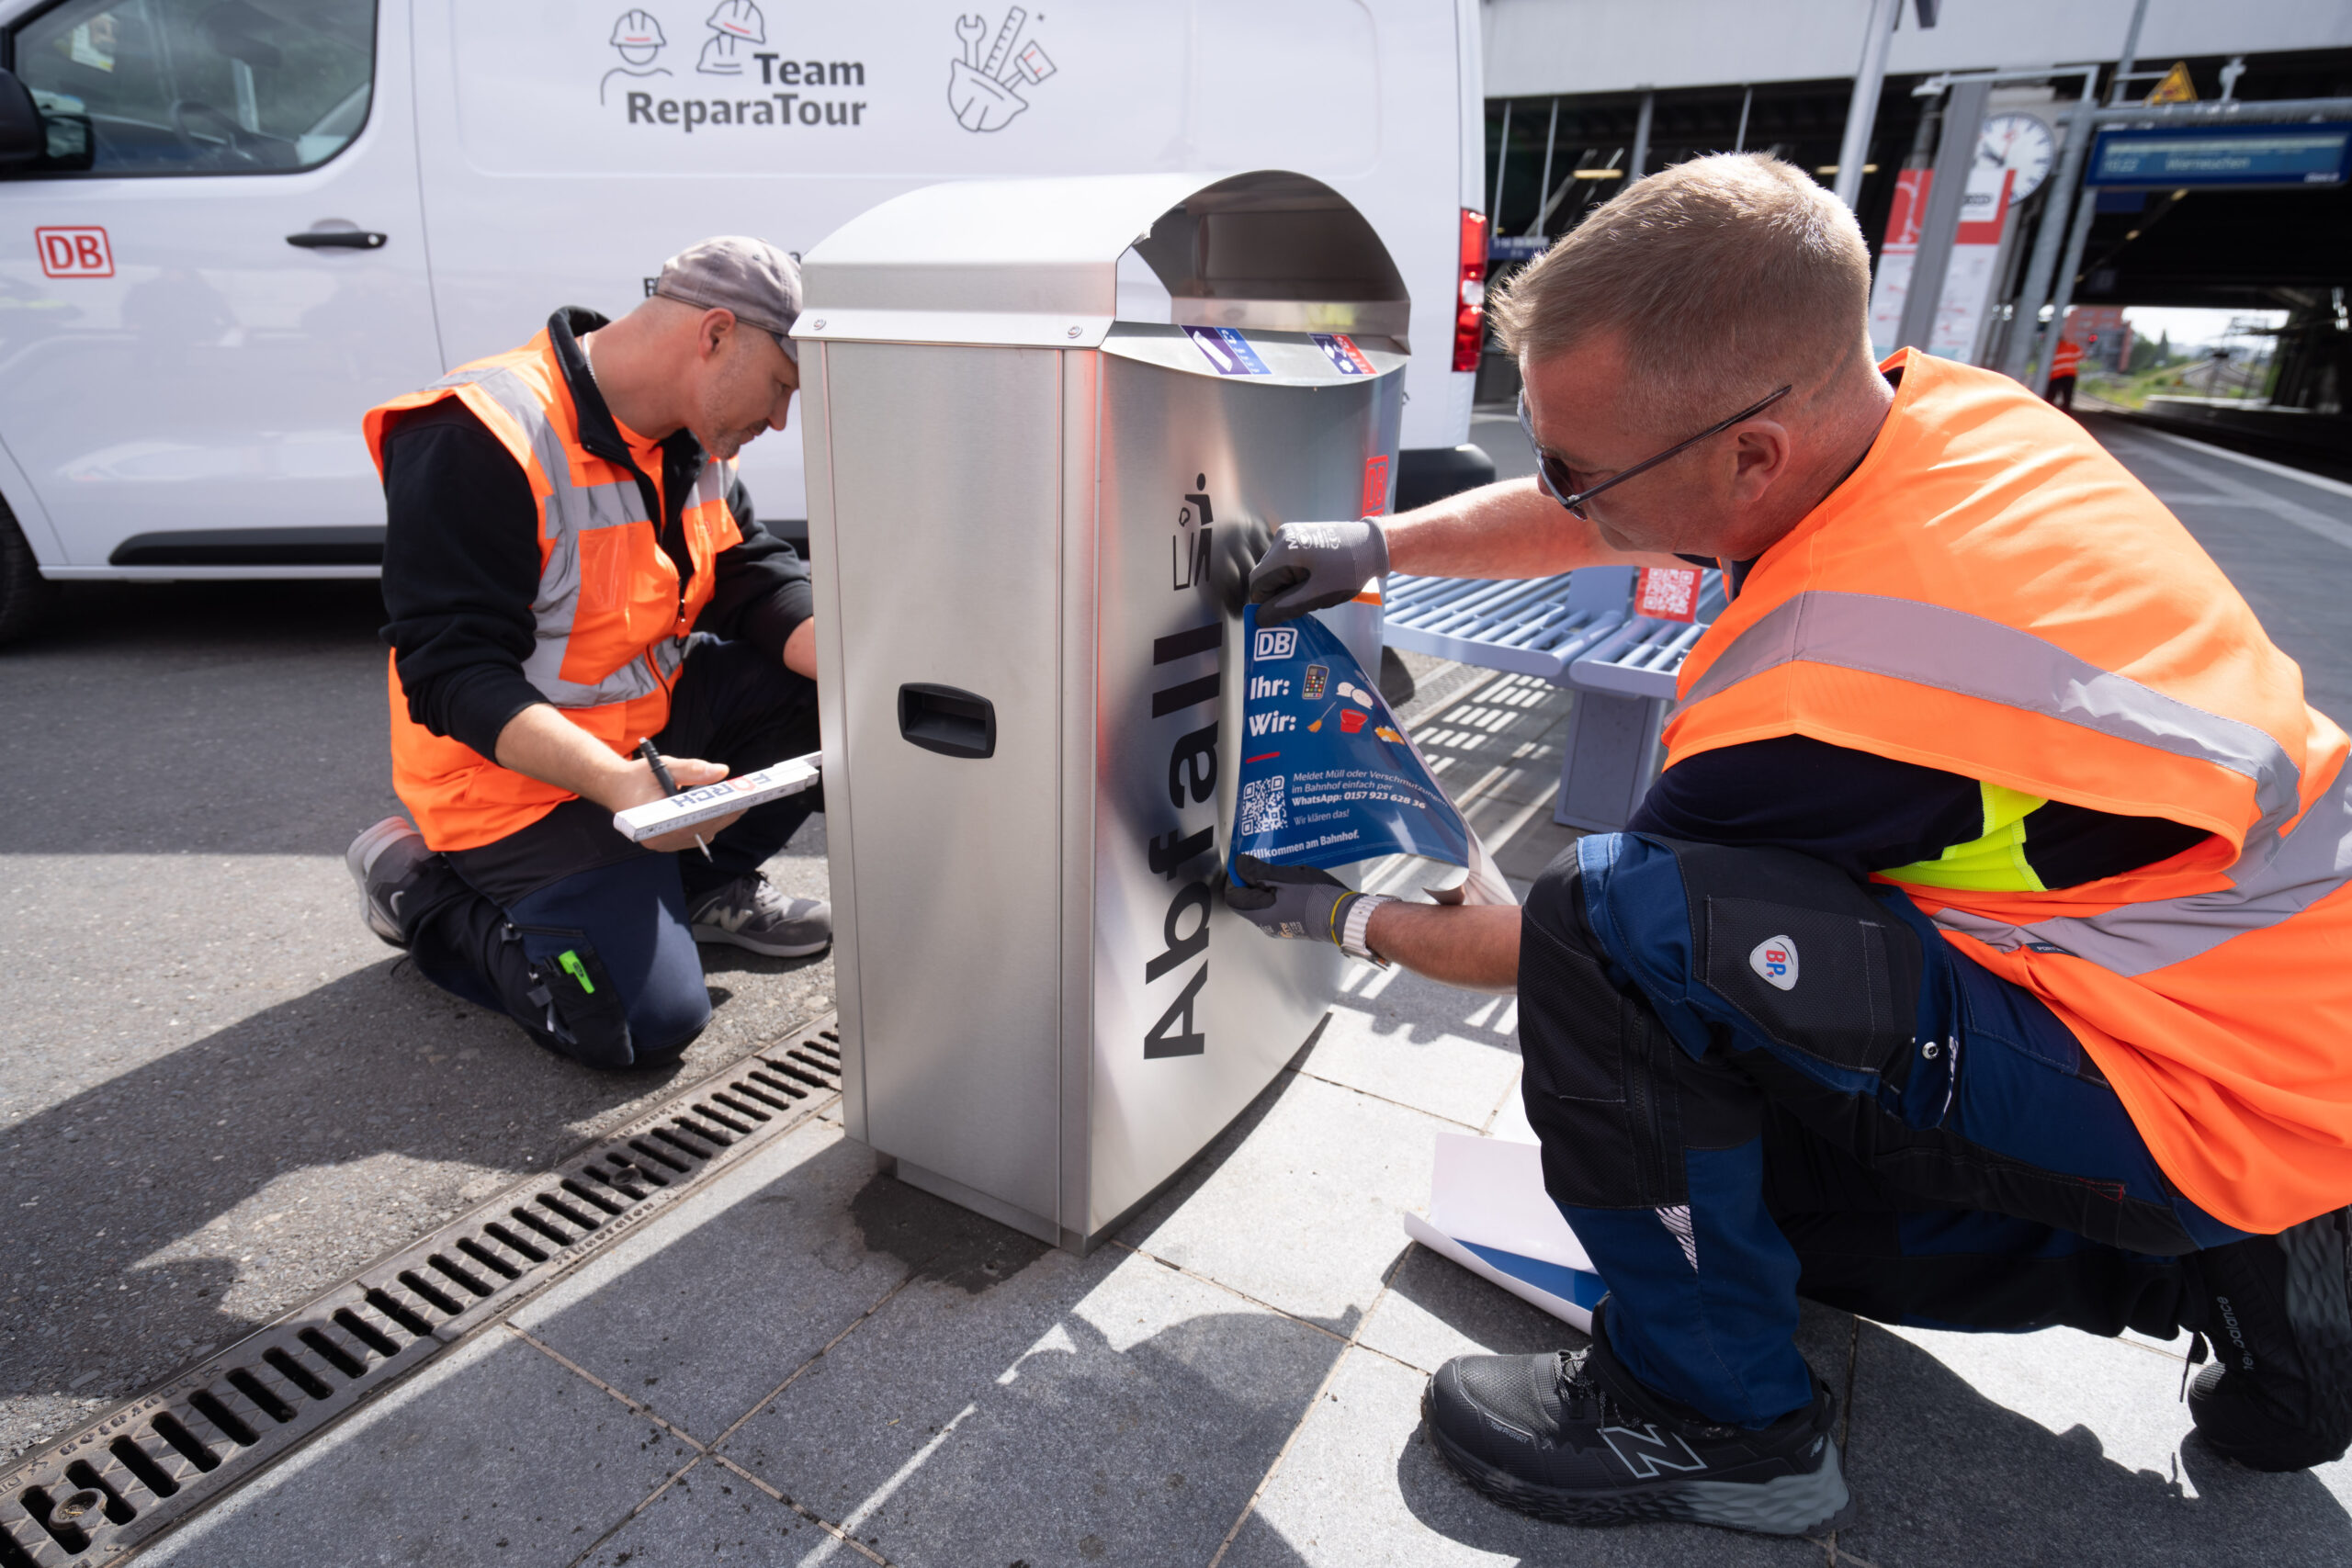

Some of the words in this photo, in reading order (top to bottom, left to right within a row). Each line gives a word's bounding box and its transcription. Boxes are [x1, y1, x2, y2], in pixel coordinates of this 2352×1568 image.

[753, 52, 865, 85] Team
[627, 91, 866, 133] ReparaTour
[45, 235, 103, 269] DB
[1366, 465, 1385, 510] DB
[1259, 632, 1291, 656] DB
[1250, 675, 1290, 700] Ihr:
[1249, 710, 1296, 737] Wir:
[1292, 785, 1303, 794] im
[1305, 781, 1340, 793] Bahnhof
[1342, 780, 1375, 789] einfach
[1376, 783, 1394, 791] per
[1293, 771, 1323, 782] Meldet
[1325, 769, 1345, 779] Müll
[1346, 769, 1368, 778] oder
[1292, 794, 1342, 807] WhatsApp:
[1344, 791, 1368, 800] 0157
[1369, 791, 1389, 800] 923
[1390, 794, 1411, 805] 628
[1412, 799, 1426, 809] 36
[1294, 816, 1306, 826] Wir
[1307, 812, 1331, 823] klären
[1332, 808, 1351, 819] das!
[1144, 622, 1223, 1059] Abfall
[1306, 839, 1318, 850] am
[1319, 829, 1360, 846] Bahnhof.
